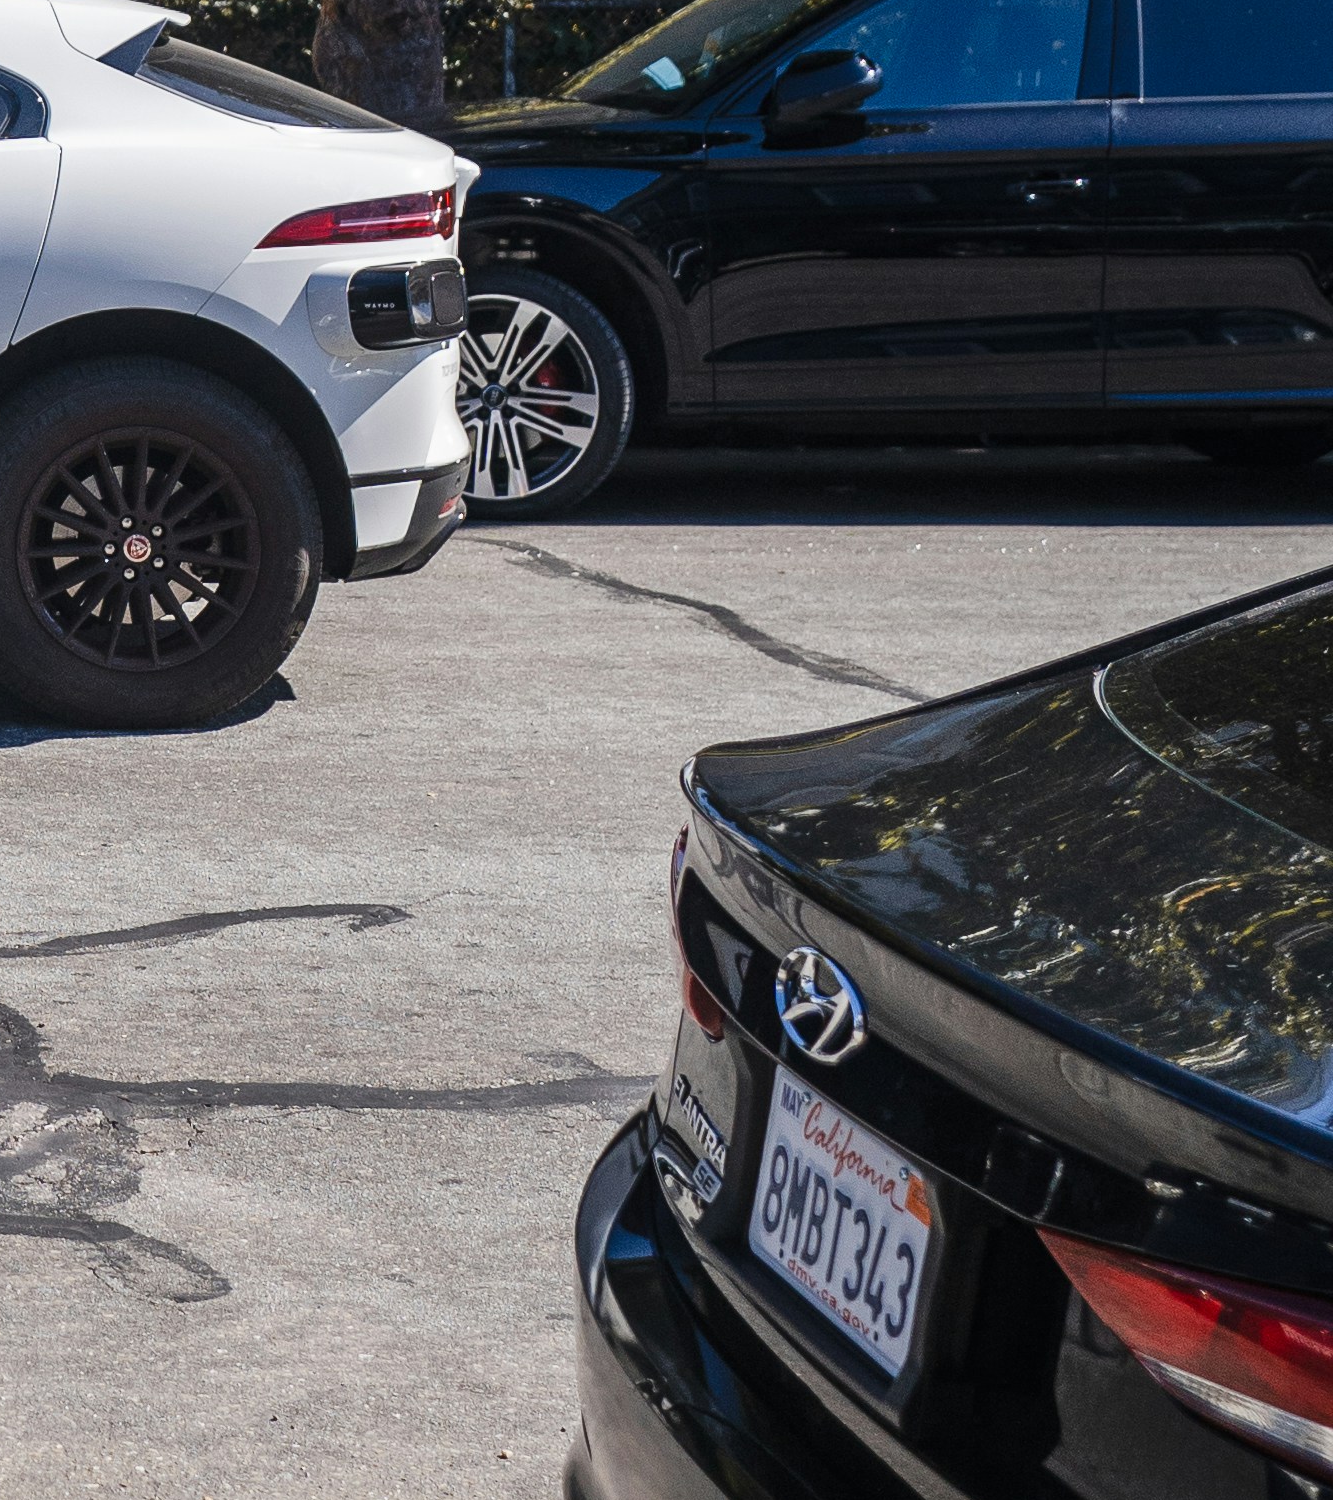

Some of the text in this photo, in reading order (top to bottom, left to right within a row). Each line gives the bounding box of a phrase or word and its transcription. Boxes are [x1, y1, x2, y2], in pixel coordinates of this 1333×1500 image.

[780, 1082, 804, 1119] MAY
[694, 1165, 716, 1196] SE
[804, 1101, 904, 1213] California
[762, 1145, 915, 1338] 8MBT343
[787, 1258, 870, 1336] dmv.ca.gov
